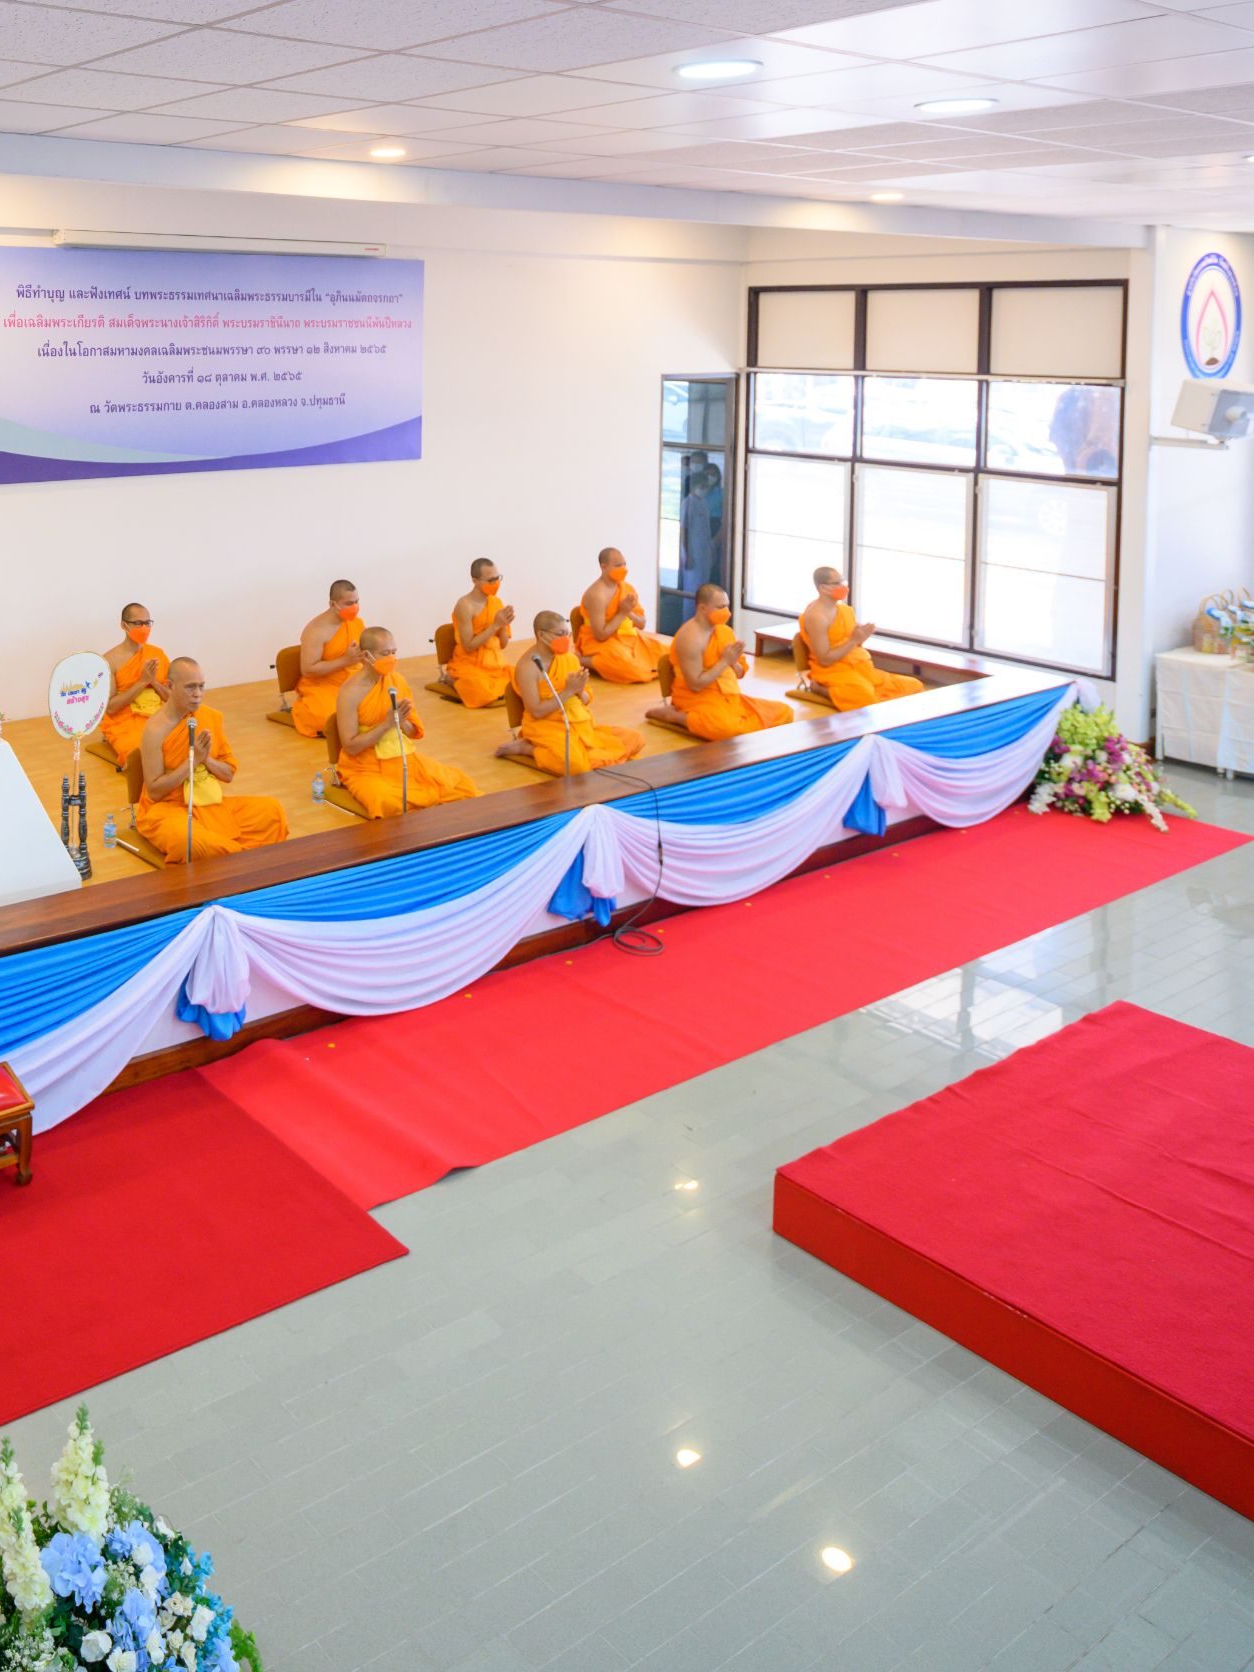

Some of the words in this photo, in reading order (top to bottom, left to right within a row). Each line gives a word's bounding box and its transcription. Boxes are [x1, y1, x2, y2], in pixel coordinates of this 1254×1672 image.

[16, 284, 65, 303] พิธีทำบุญ
[69, 285, 132, 300] และฟังเทศน์
[3, 309, 105, 328] เพื่อเฉลิมพระเกียรติ
[274, 346, 304, 355] พรรษา
[323, 342, 358, 355] สิงหาคม
[142, 367, 194, 384] วันอังคารที่
[197, 374, 212, 383] ๑๘
[215, 372, 247, 386] ตุลาคม
[250, 372, 270, 382] พ.ศ.
[273, 371, 303, 381] ๒๕๖๕
[90, 404, 100, 414] ณ
[104, 401, 182, 413] วัดพระธรรมกาย
[185, 399, 239, 411] ต.คลองสาม
[241, 397, 298, 410] อ.คลองหลวง
[301, 393, 346, 410] จ.ปทุมธานี
